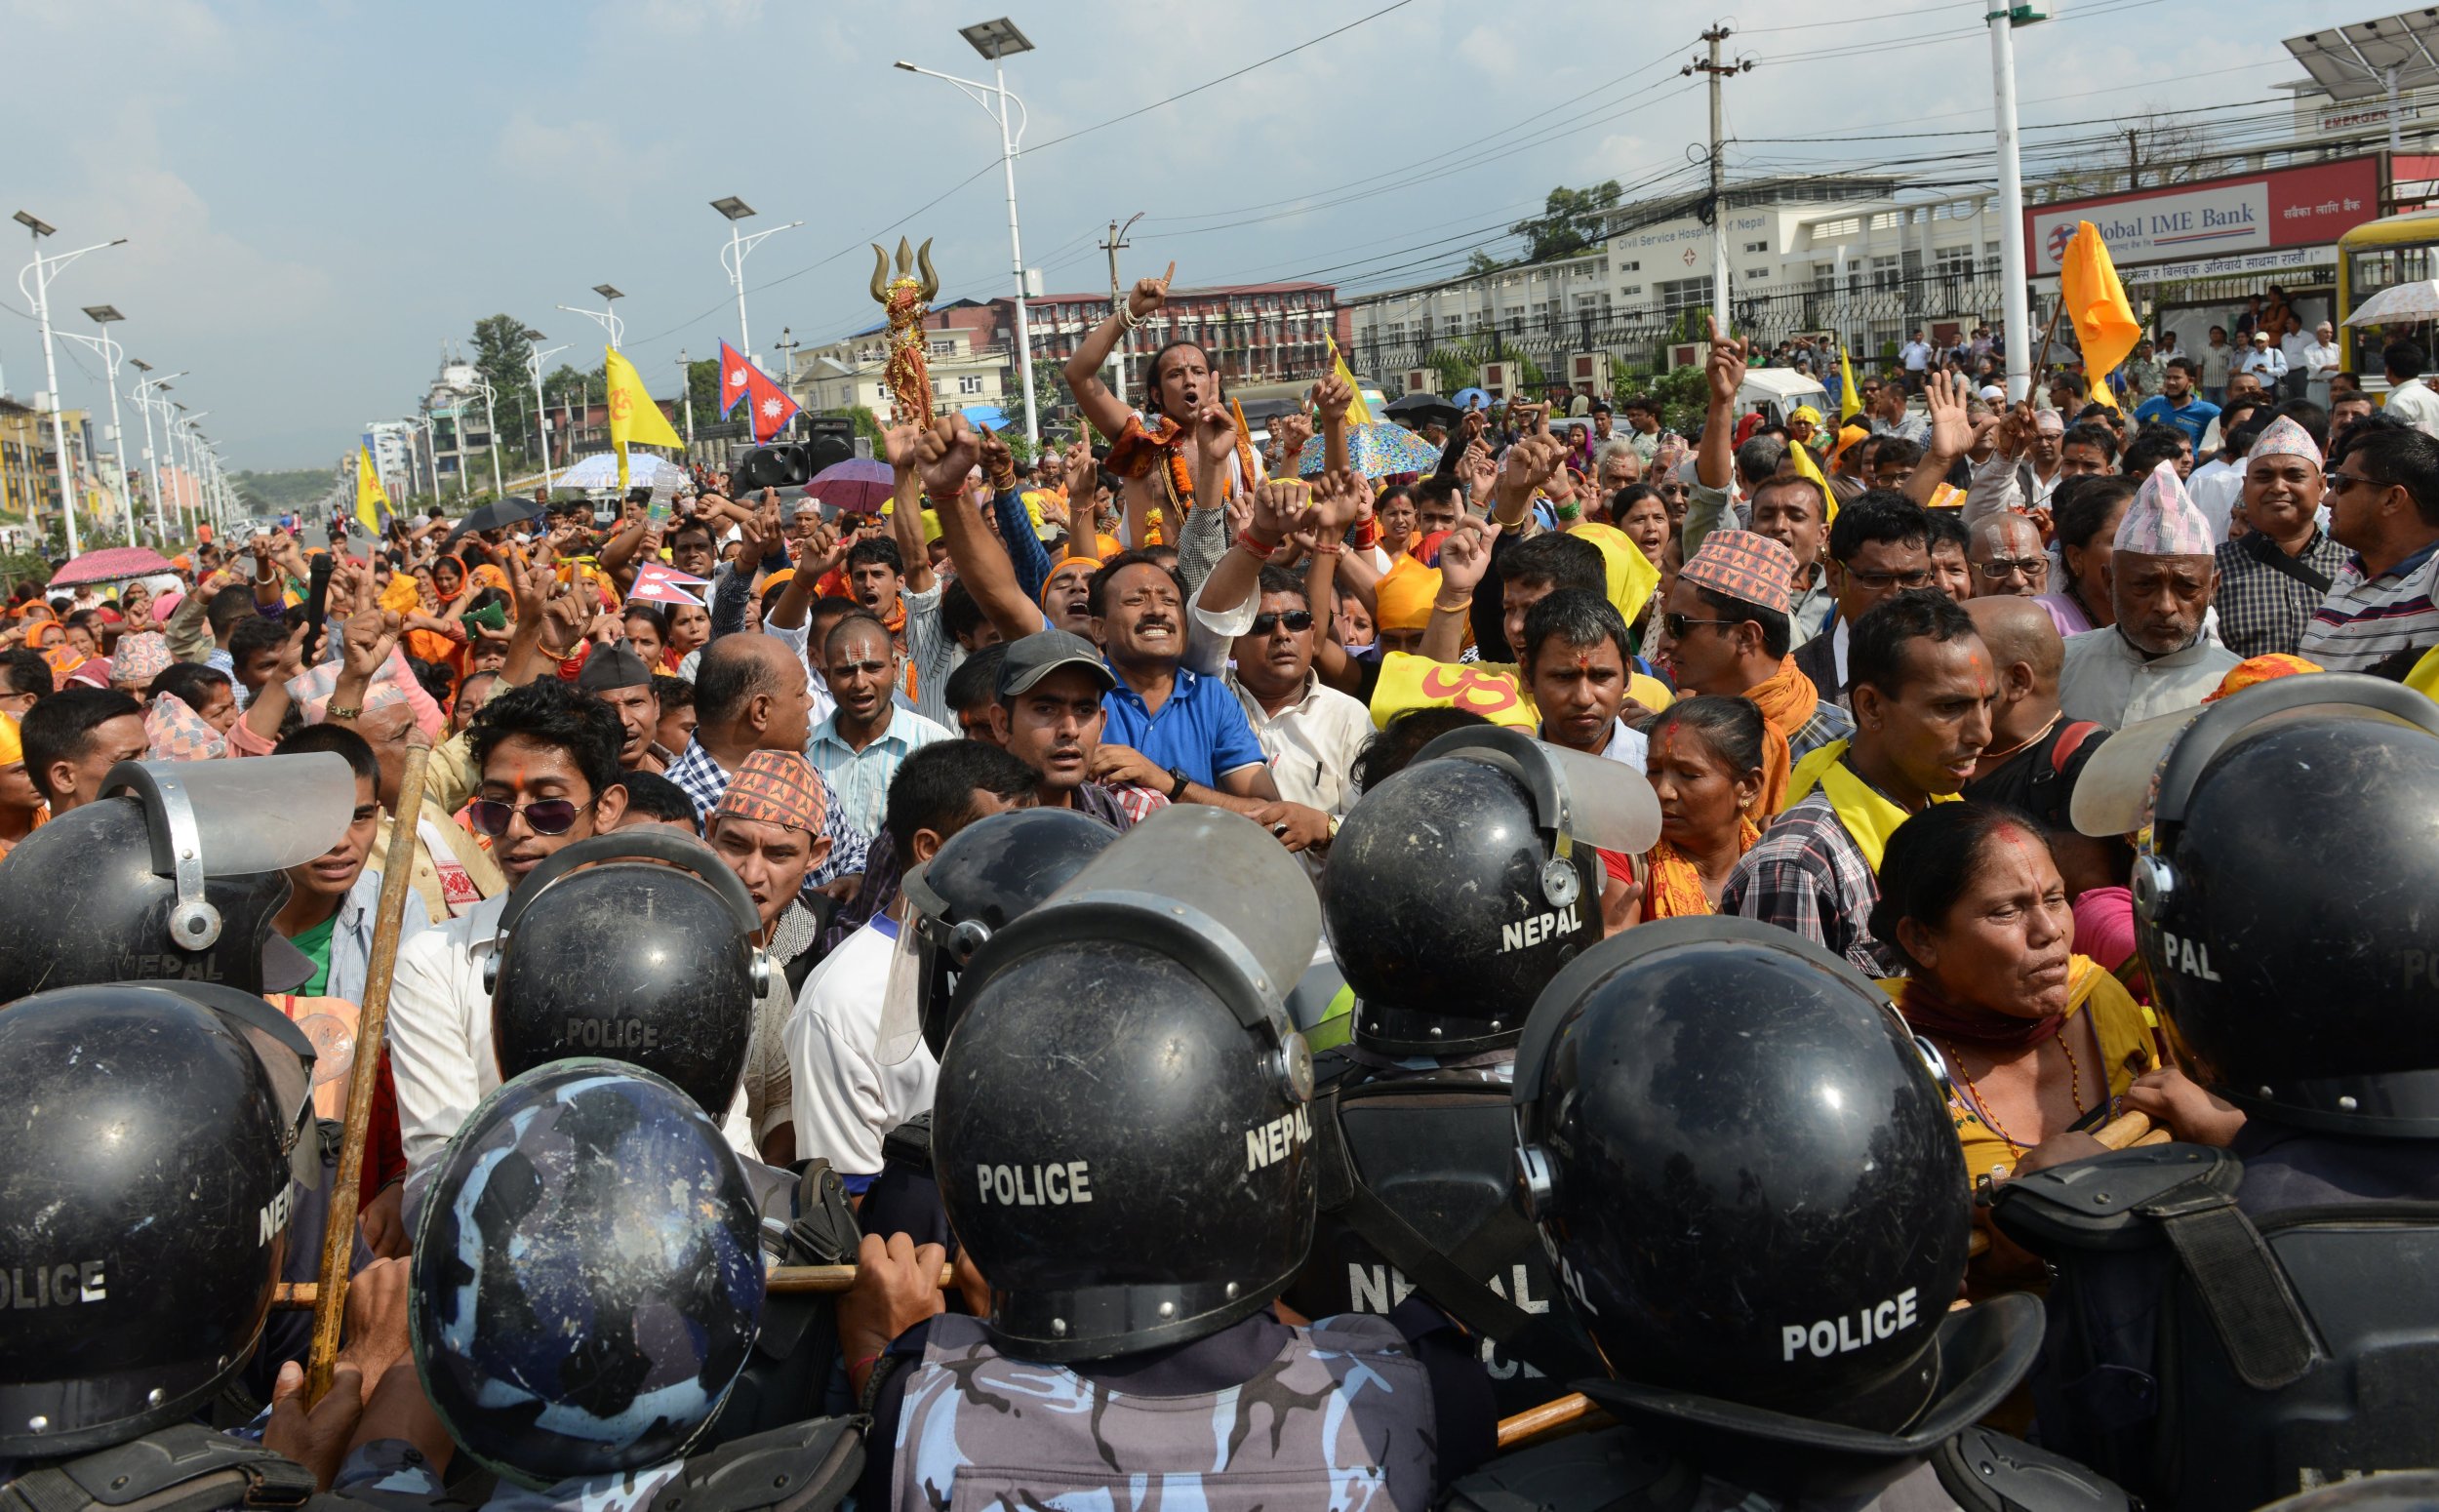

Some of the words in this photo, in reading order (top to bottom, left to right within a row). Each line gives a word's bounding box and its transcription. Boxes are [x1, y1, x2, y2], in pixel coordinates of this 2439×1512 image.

[2325, 107, 2407, 130] EMERGENY
[1619, 238, 1638, 251] Civil
[1640, 231, 1675, 247] Service
[1738, 216, 1766, 231] Nepal
[2097, 217, 2142, 241] lobal
[2151, 211, 2193, 234] IME
[2202, 203, 2255, 228] Bank
[1501, 903, 1582, 953] NEPAL
[566, 1016, 659, 1049] POLICE
[1245, 1101, 1313, 1173] NEPAL
[977, 1160, 1094, 1207] POLICE
[1781, 1287, 1918, 1362] POLICE
